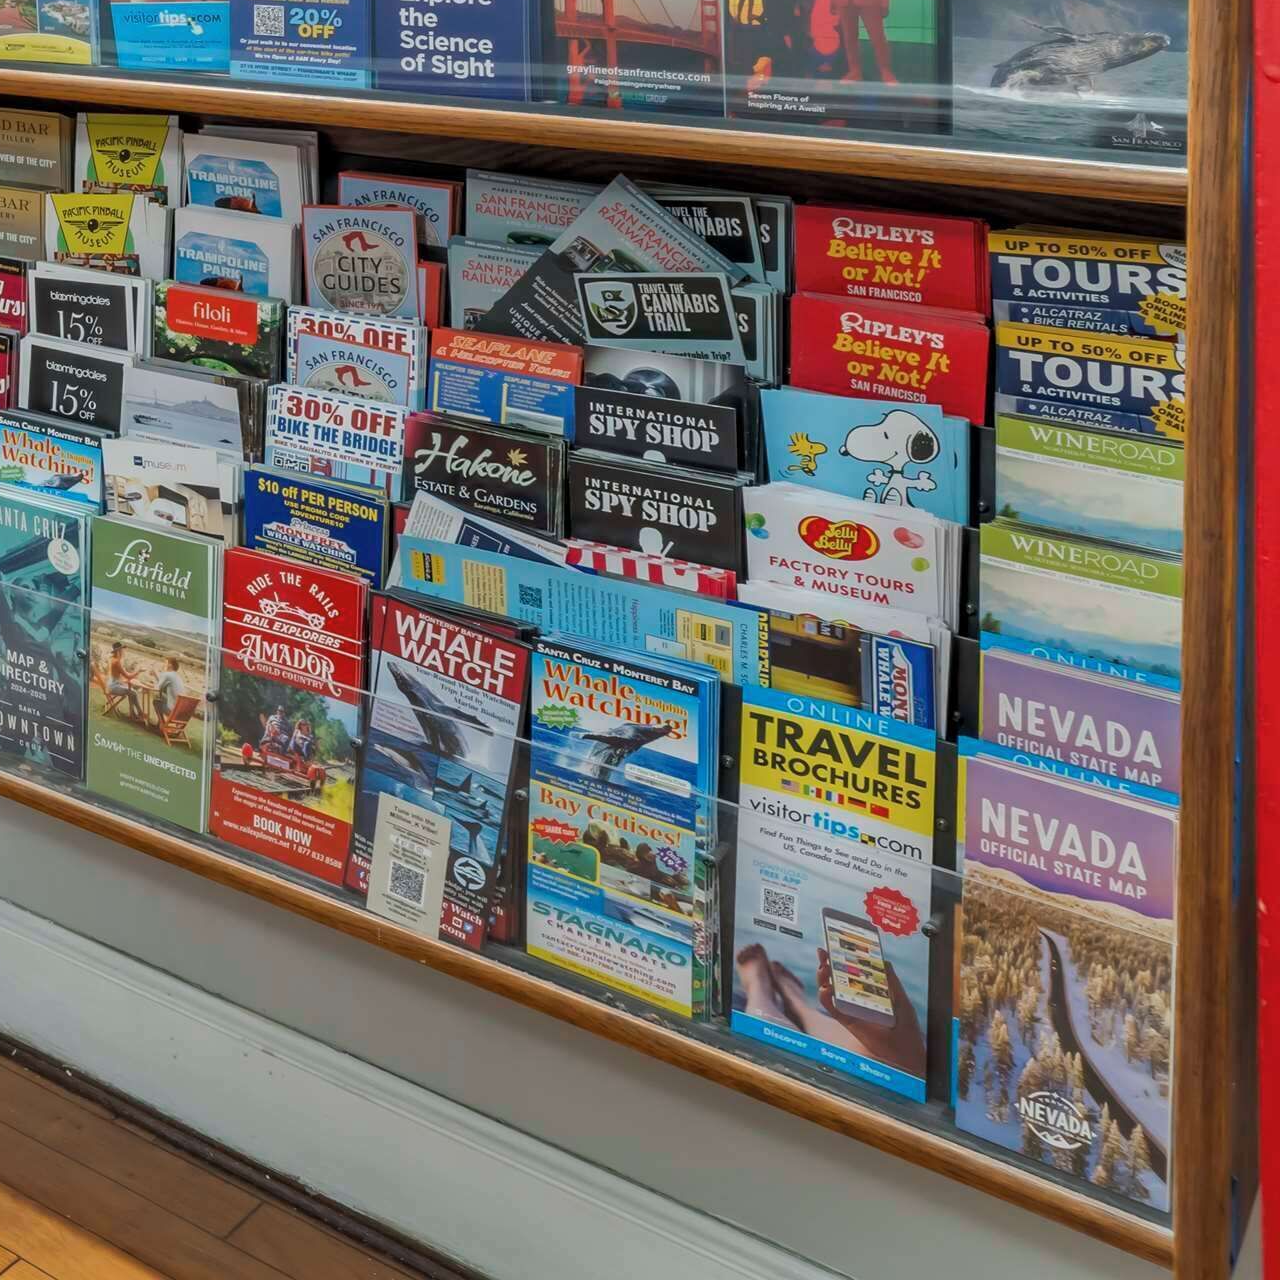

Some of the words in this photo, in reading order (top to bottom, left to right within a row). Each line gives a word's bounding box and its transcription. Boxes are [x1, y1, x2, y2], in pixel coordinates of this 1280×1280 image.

[289, 7, 343, 27] 20%
[399, 7, 438, 29] the
[298, 23, 335, 39] OFF
[400, 30, 493, 54] Science
[400, 53, 425, 74] of
[426, 54, 495, 79] Sight
[566, 62, 711, 84] graylineofsanfrancisco.com
[191, 171, 277, 190] TRAMPOLINE
[216, 184, 253, 198] PARK
[832, 217, 935, 245] RIPLEY'S
[827, 239, 914, 267] Believe
[918, 251, 942, 269] It
[1005, 240, 1030, 251] UP
[1034, 242, 1061, 252] TO
[1068, 245, 1107, 257] 50%
[1114, 247, 1152, 260] OFF
[338, 256, 384, 273] CITY
[843, 265, 870, 282] or
[873, 267, 926, 289] Not!
[998, 256, 1187, 299] TOURS
[322, 273, 401, 295] GUIDES
[638, 283, 665, 295] TRAVEL
[667, 284, 685, 294] THE
[1013, 287, 1024, 296] &
[1028, 289, 1110, 303] ACTIVITIES
[193, 301, 231, 323] filoli
[642, 294, 720, 314] CANNABIS
[1032, 307, 1102, 321] ALCATRAZ
[647, 312, 691, 332] TRAIL
[287, 394, 345, 426] 30%
[350, 408, 397, 437] OFF
[589, 402, 717, 430] INTERNATIONAL
[277, 415, 310, 439] BIKE
[313, 422, 340, 444] THE
[342, 430, 398, 458] BRIDGE
[589, 415, 639, 441] SPY
[645, 423, 720, 453] SHOP
[414, 432, 537, 486] Hakone
[258, 478, 279, 493] $10
[282, 486, 298, 498] off
[301, 489, 326, 507] PER
[327, 496, 378, 521] PERSON
[106, 539, 192, 590] fairfield
[1009, 533, 1159, 581] WINEROAD
[126, 575, 186, 600] CALIFORNIA
[769, 554, 848, 579] FACTORY
[854, 574, 915, 595] TOURS
[793, 575, 807, 589] &
[811, 580, 890, 605] MUSEUM
[395, 610, 516, 678] WHALE
[237, 633, 342, 696] AMADOR
[400, 636, 504, 695] WATCH
[980, 796, 1148, 882] NEVADA
[980, 838, 1048, 871] OFFICIAL
[1053, 860, 1105, 888] STATE
[1109, 875, 1148, 901] MAP
[532, 901, 687, 966] STAGNARO
